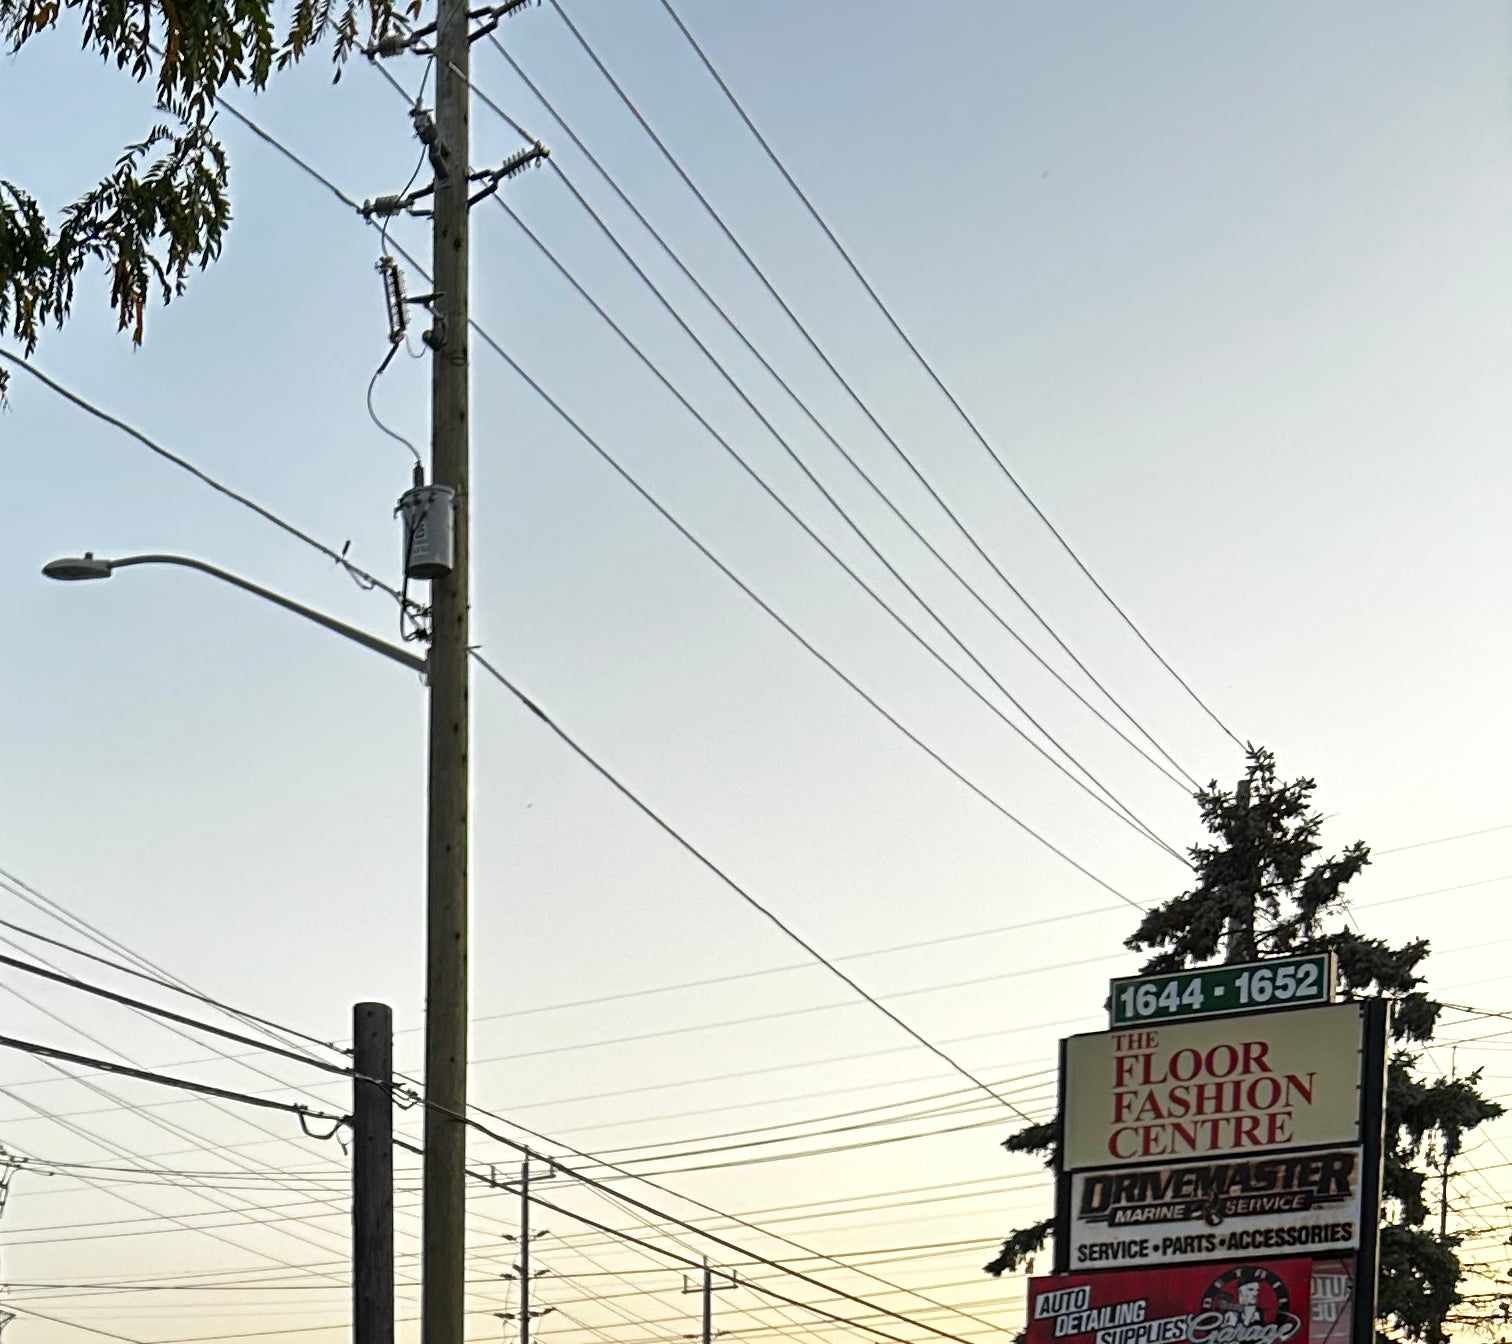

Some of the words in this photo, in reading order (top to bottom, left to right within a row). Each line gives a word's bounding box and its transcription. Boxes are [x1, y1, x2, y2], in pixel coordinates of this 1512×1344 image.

[1120, 977, 1204, 1018] 1644
[1235, 963, 1318, 1004] 1652
[1111, 1031, 1159, 1052] THE
[1112, 1041, 1273, 1088] FLOOR
[1111, 1072, 1317, 1125] FASHION
[1107, 1111, 1293, 1160] CENTRE
[1078, 1153, 1356, 1216] DRIVEMASTER
[1115, 1204, 1186, 1224] MARINE
[1224, 1194, 1305, 1214] SERVICE
[1077, 1239, 1149, 1263] SERVICE
[1161, 1233, 1216, 1256] PARTS
[1227, 1222, 1353, 1251] ACCESSORIES
[1039, 1288, 1087, 1316] AUTO
[1054, 1300, 1147, 1338] DETAILING
